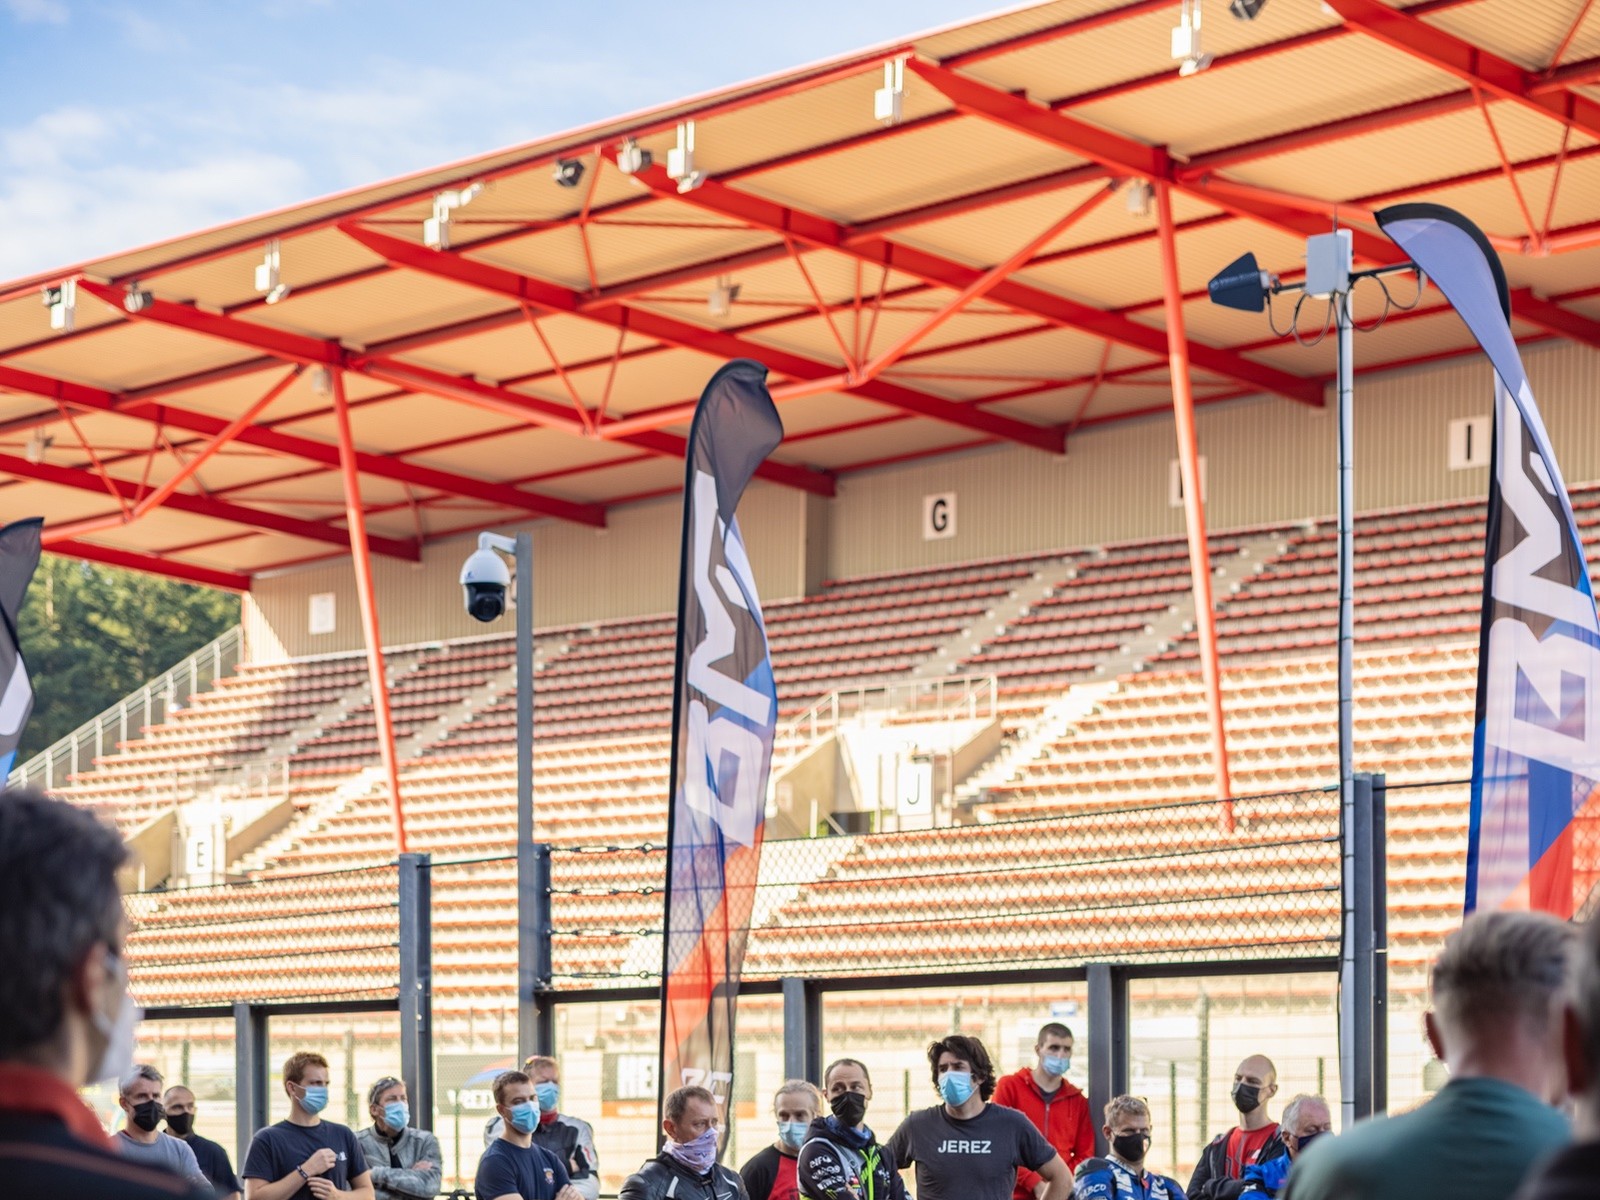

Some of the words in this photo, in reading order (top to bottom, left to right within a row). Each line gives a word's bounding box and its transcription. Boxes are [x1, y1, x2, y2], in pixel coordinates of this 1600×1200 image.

[932, 499, 947, 532] G
[907, 773, 921, 805] J
[196, 841, 205, 868] E
[938, 1140, 992, 1154] JEREZ
